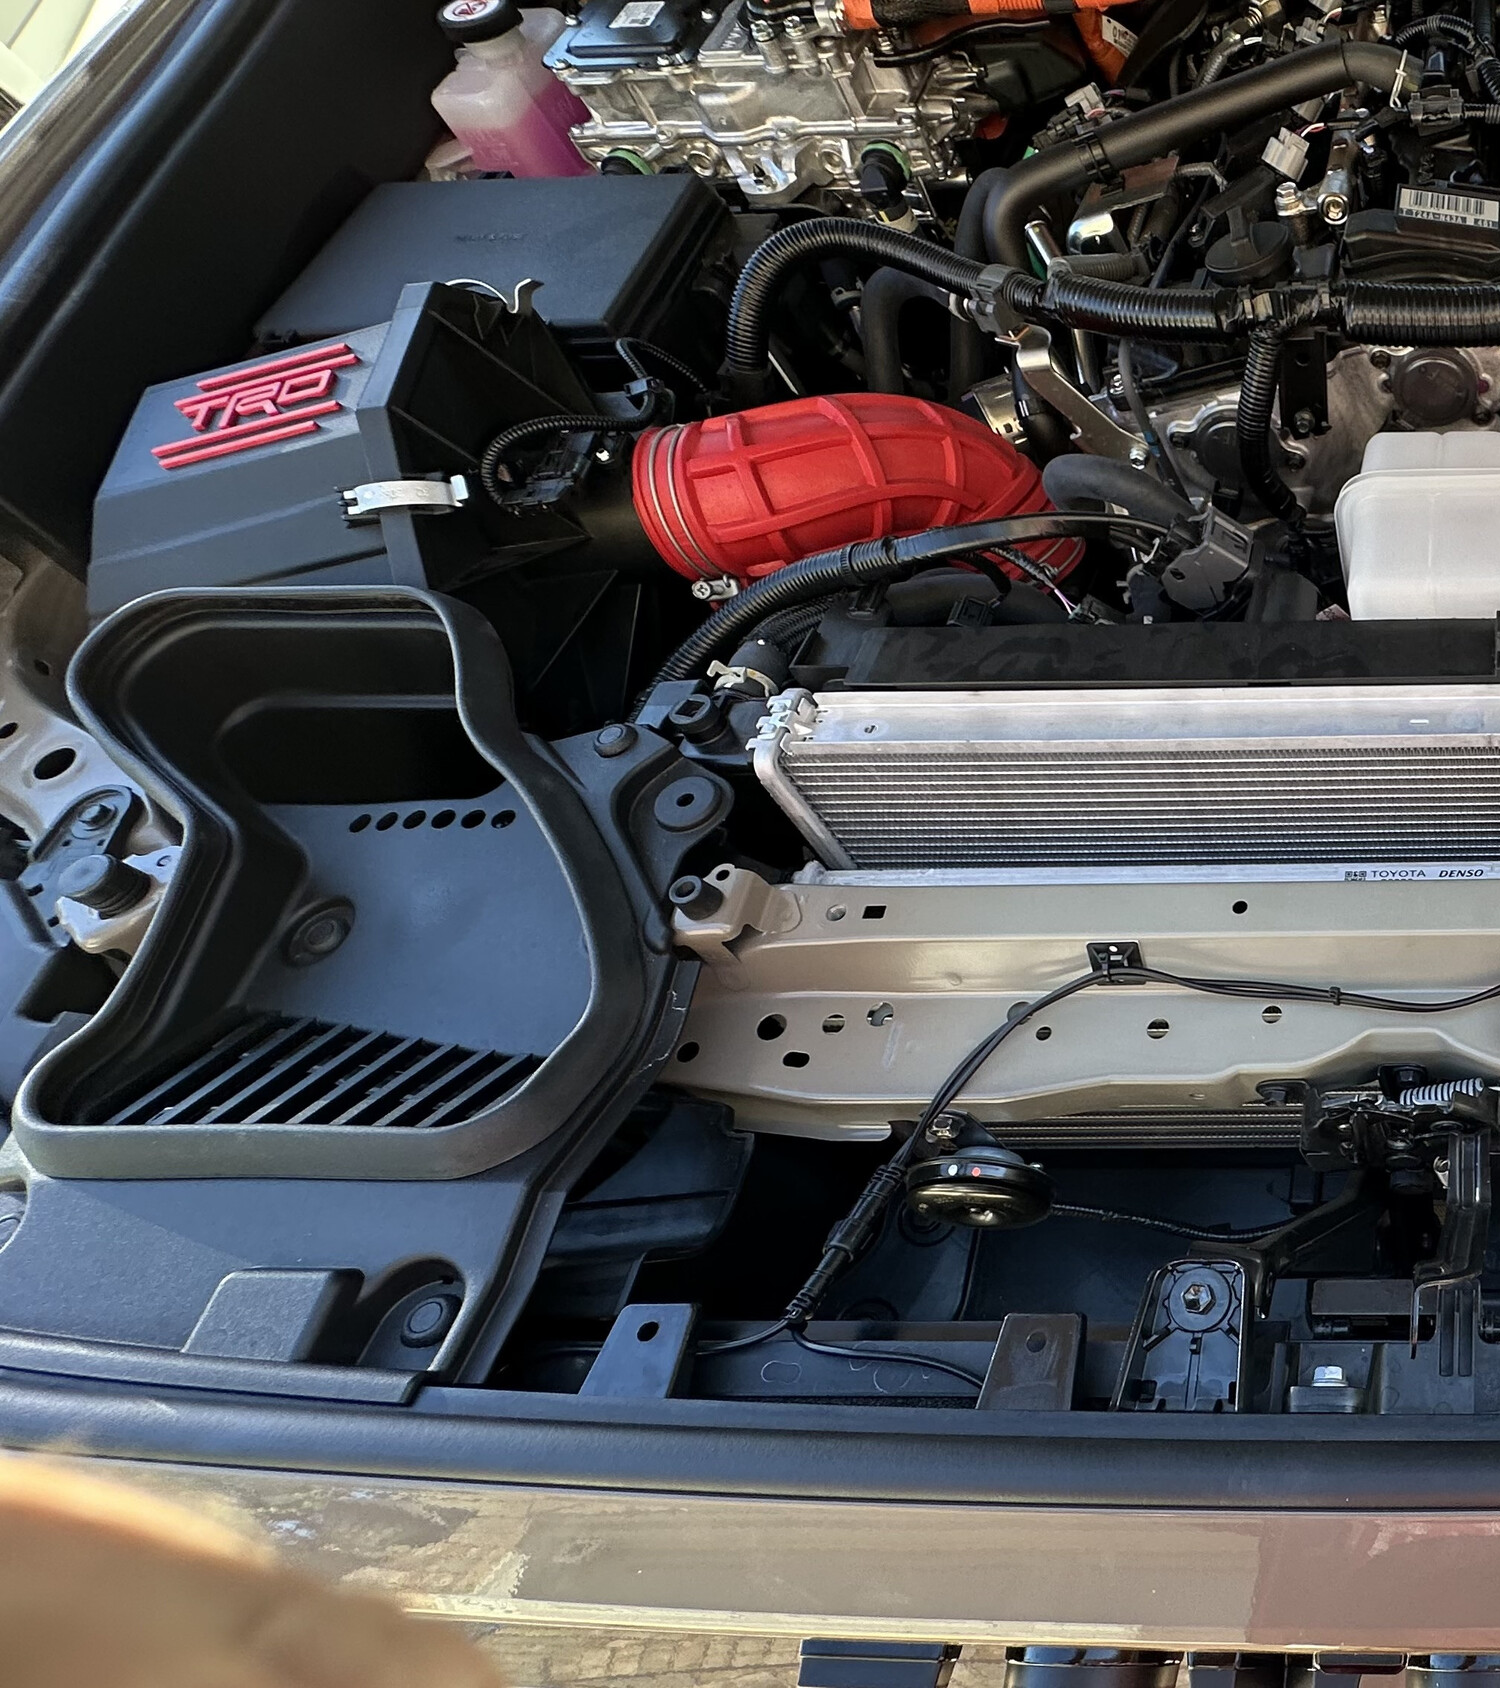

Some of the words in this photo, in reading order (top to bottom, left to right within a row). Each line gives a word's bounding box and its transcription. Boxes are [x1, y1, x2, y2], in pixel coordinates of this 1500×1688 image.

[180, 368, 337, 431] TRD
[1371, 869, 1426, 878] TOYOTA
[1438, 869, 1484, 878] DENSO
